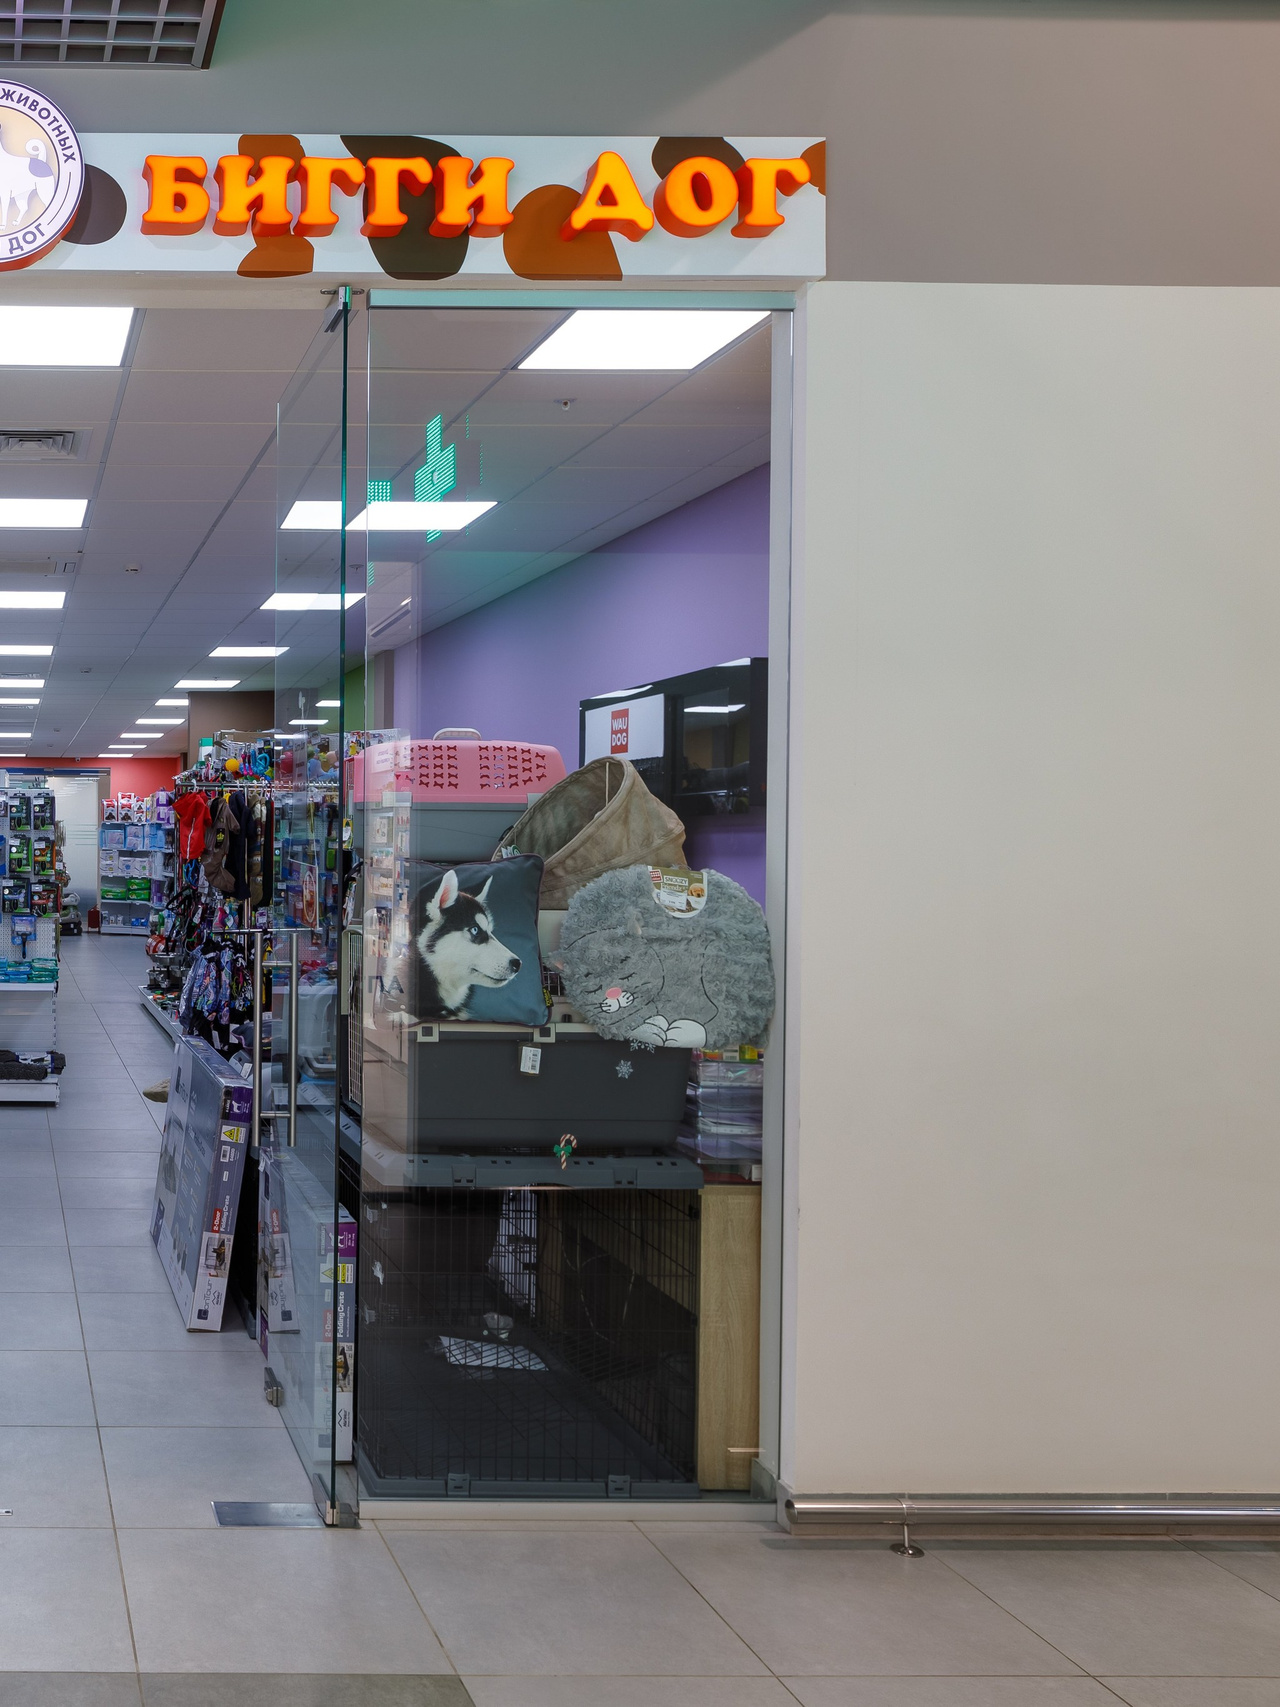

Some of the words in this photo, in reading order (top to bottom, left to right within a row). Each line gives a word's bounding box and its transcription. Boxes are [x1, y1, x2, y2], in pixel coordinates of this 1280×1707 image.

[0, 87, 77, 164] ЖИВОТНЫХ
[141, 154, 515, 238] БИГГИ
[561, 151, 812, 242] ДОГ
[8, 223, 49, 255] ДОГ
[611, 716, 628, 731] WAU
[611, 732, 628, 746] DOG
[223, 1194, 231, 1212] Crate
[213, 1210, 221, 1231] 2-Door
[220, 1211, 229, 1232] Folding
[337, 1290, 345, 1312] Crate
[336, 1312, 345, 1338] Folding
